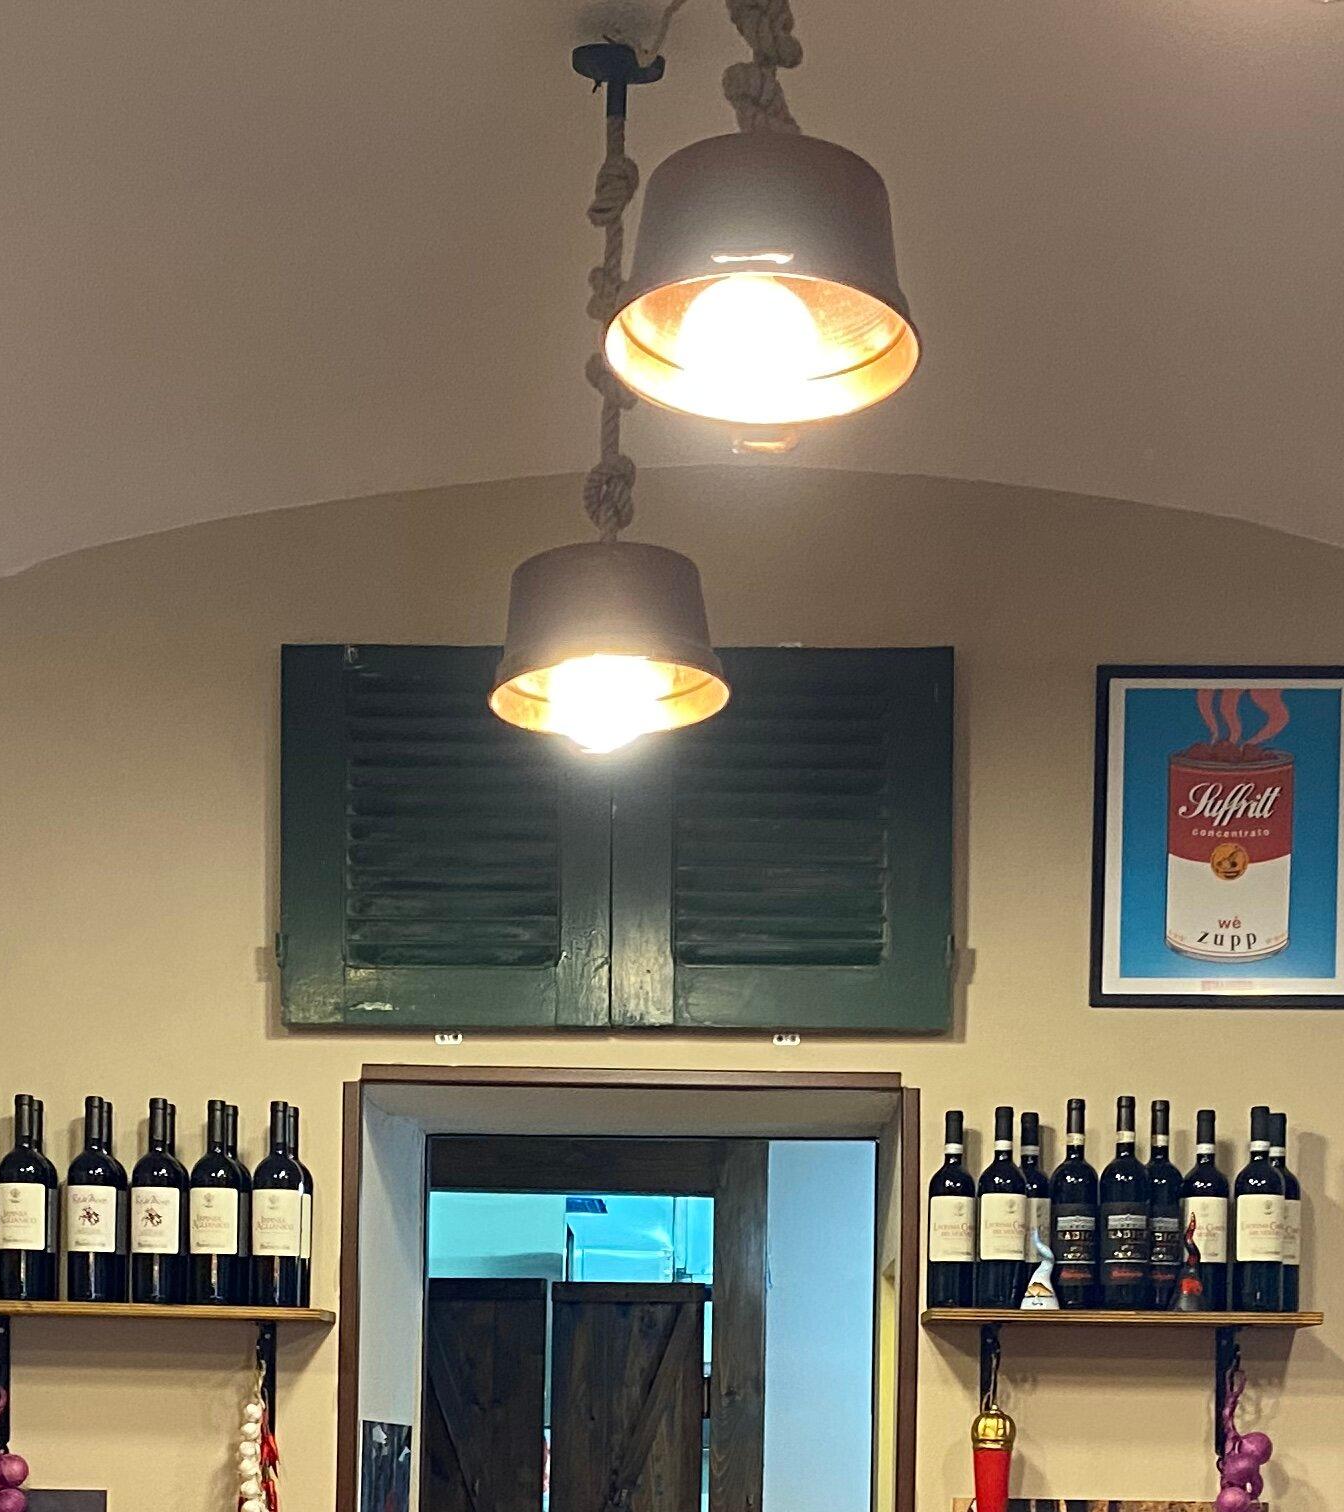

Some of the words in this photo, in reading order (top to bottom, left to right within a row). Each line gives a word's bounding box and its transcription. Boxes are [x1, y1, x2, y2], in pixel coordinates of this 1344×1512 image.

[1178, 782, 1282, 827] Suffritt
[1191, 828, 1271, 838] concentrato
[1197, 930, 1257, 952] zupp
